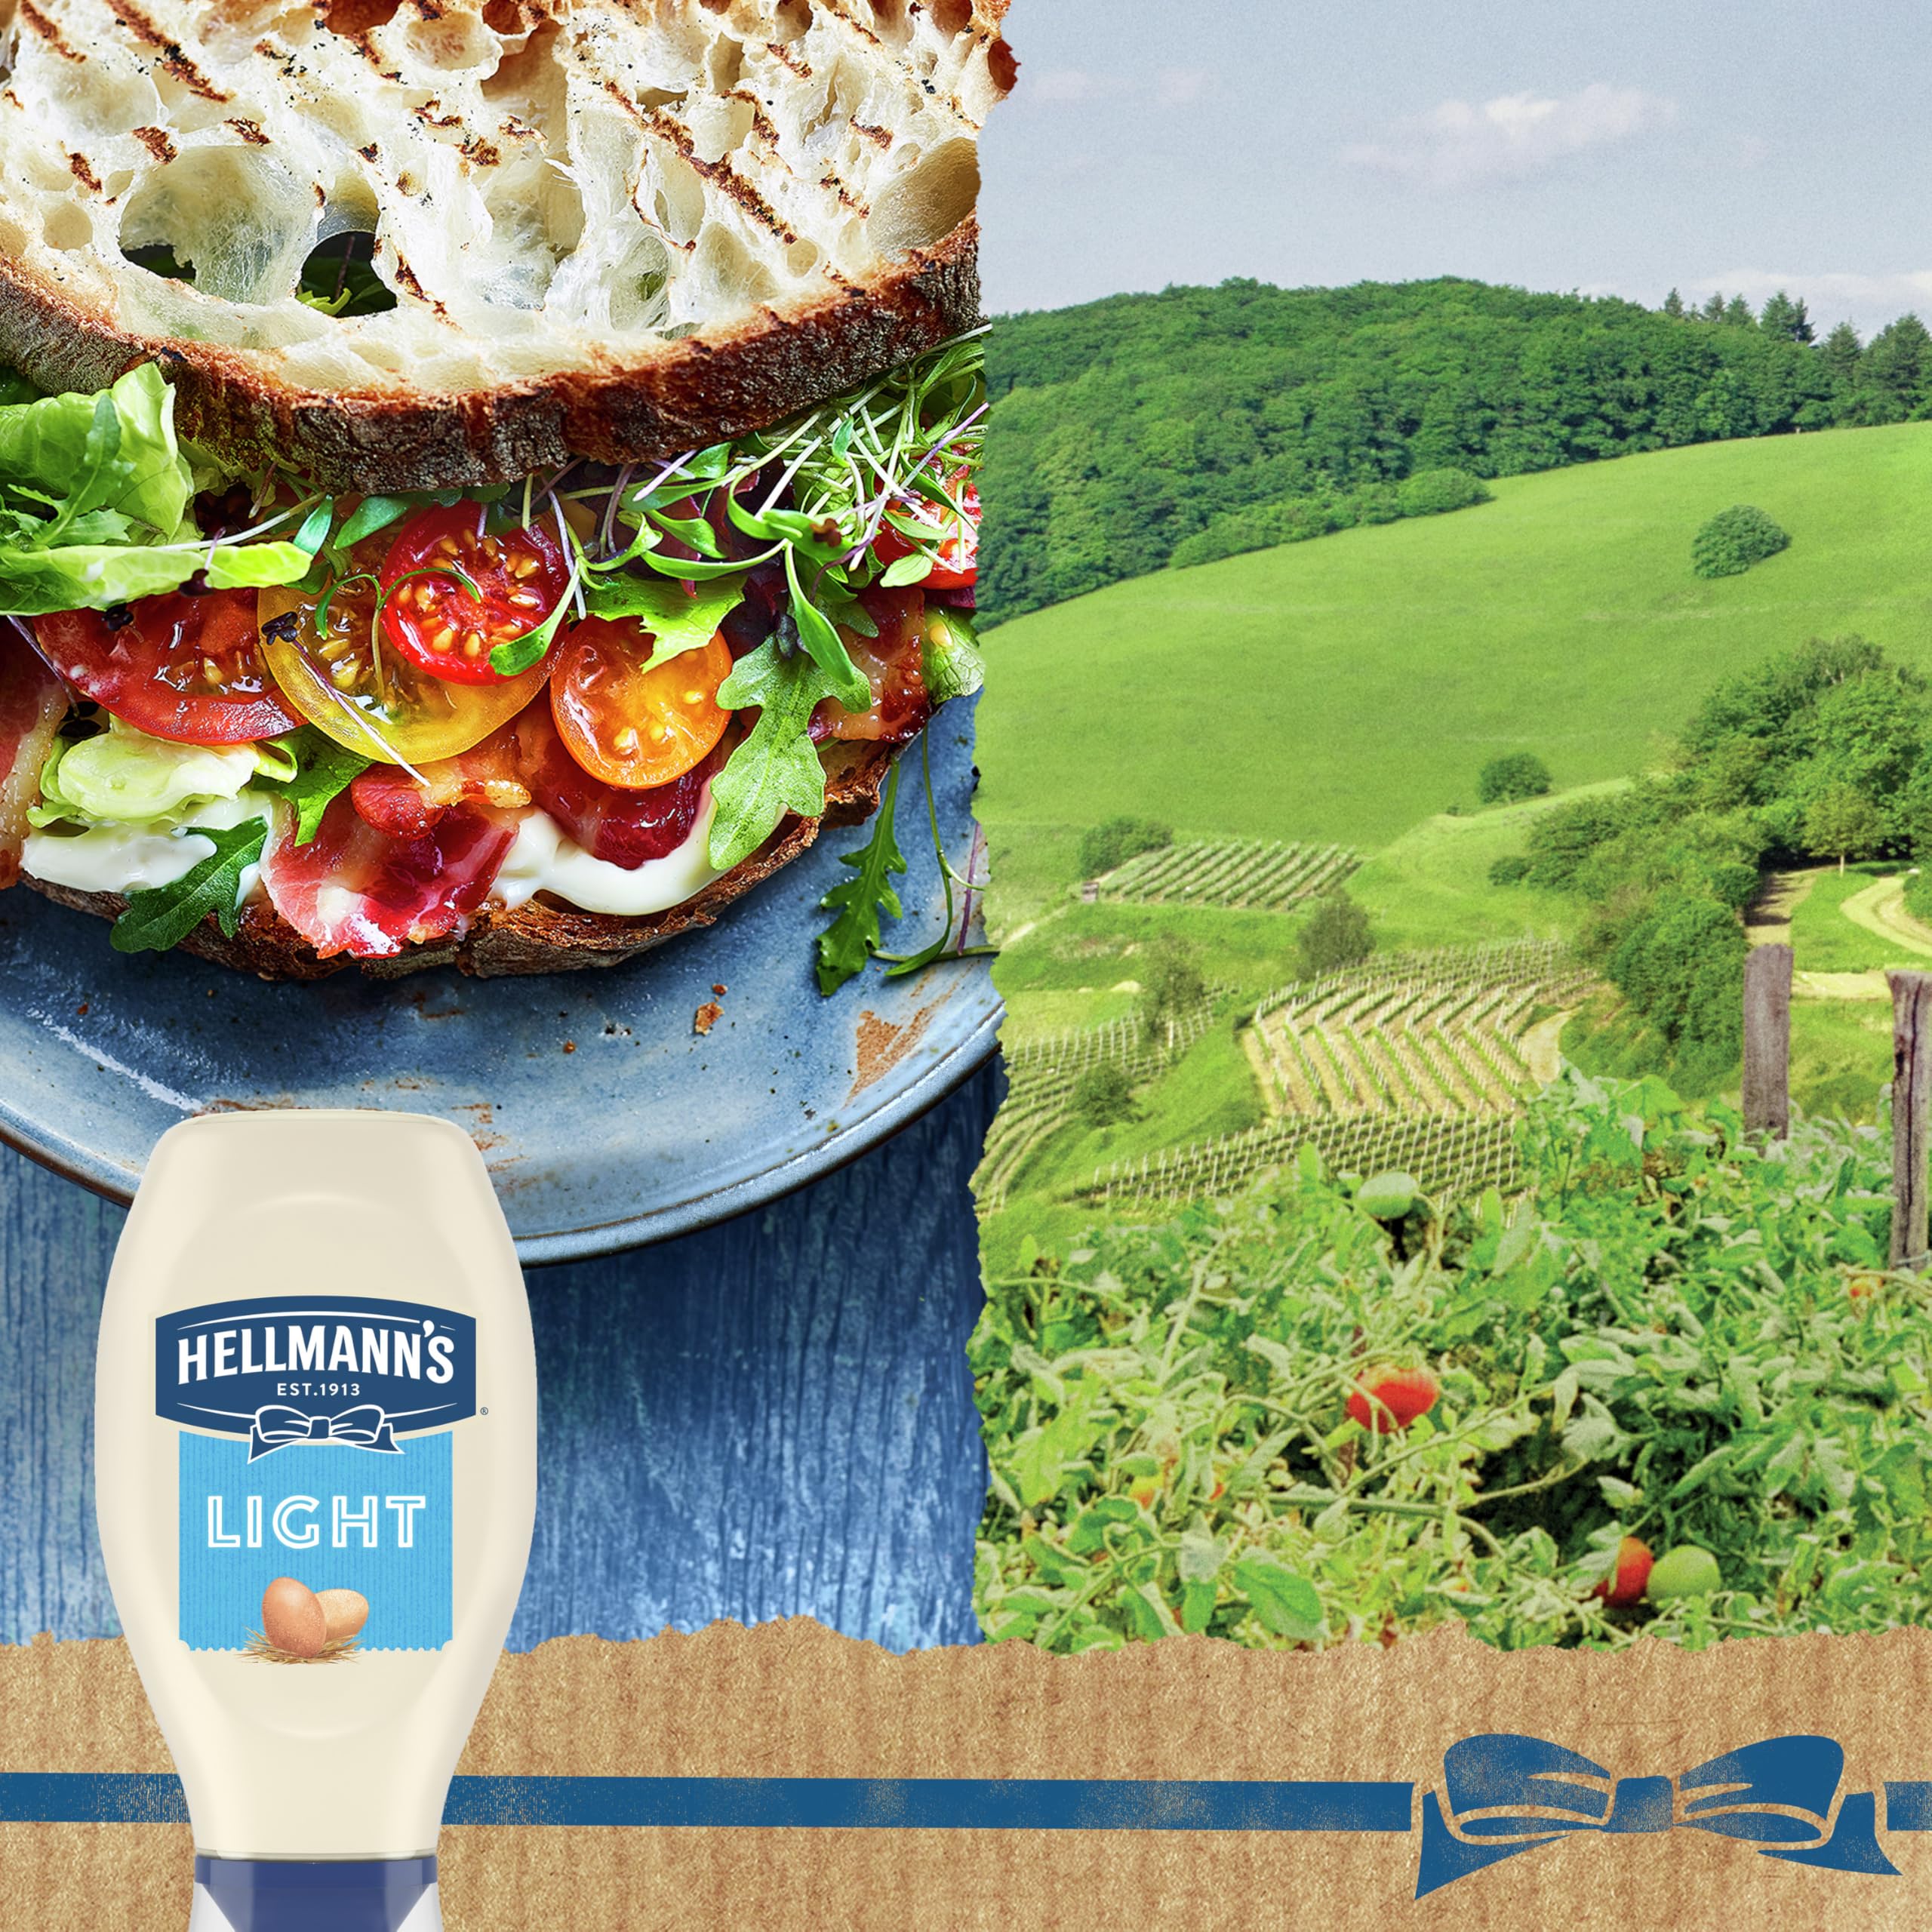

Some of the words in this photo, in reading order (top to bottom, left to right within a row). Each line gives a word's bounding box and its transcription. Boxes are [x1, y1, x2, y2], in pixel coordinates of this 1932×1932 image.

[178, 1319, 454, 1384] HELLMANN'S
[277, 1383, 361, 1396] EST.1913
[208, 1495, 426, 1549] LIGHT
